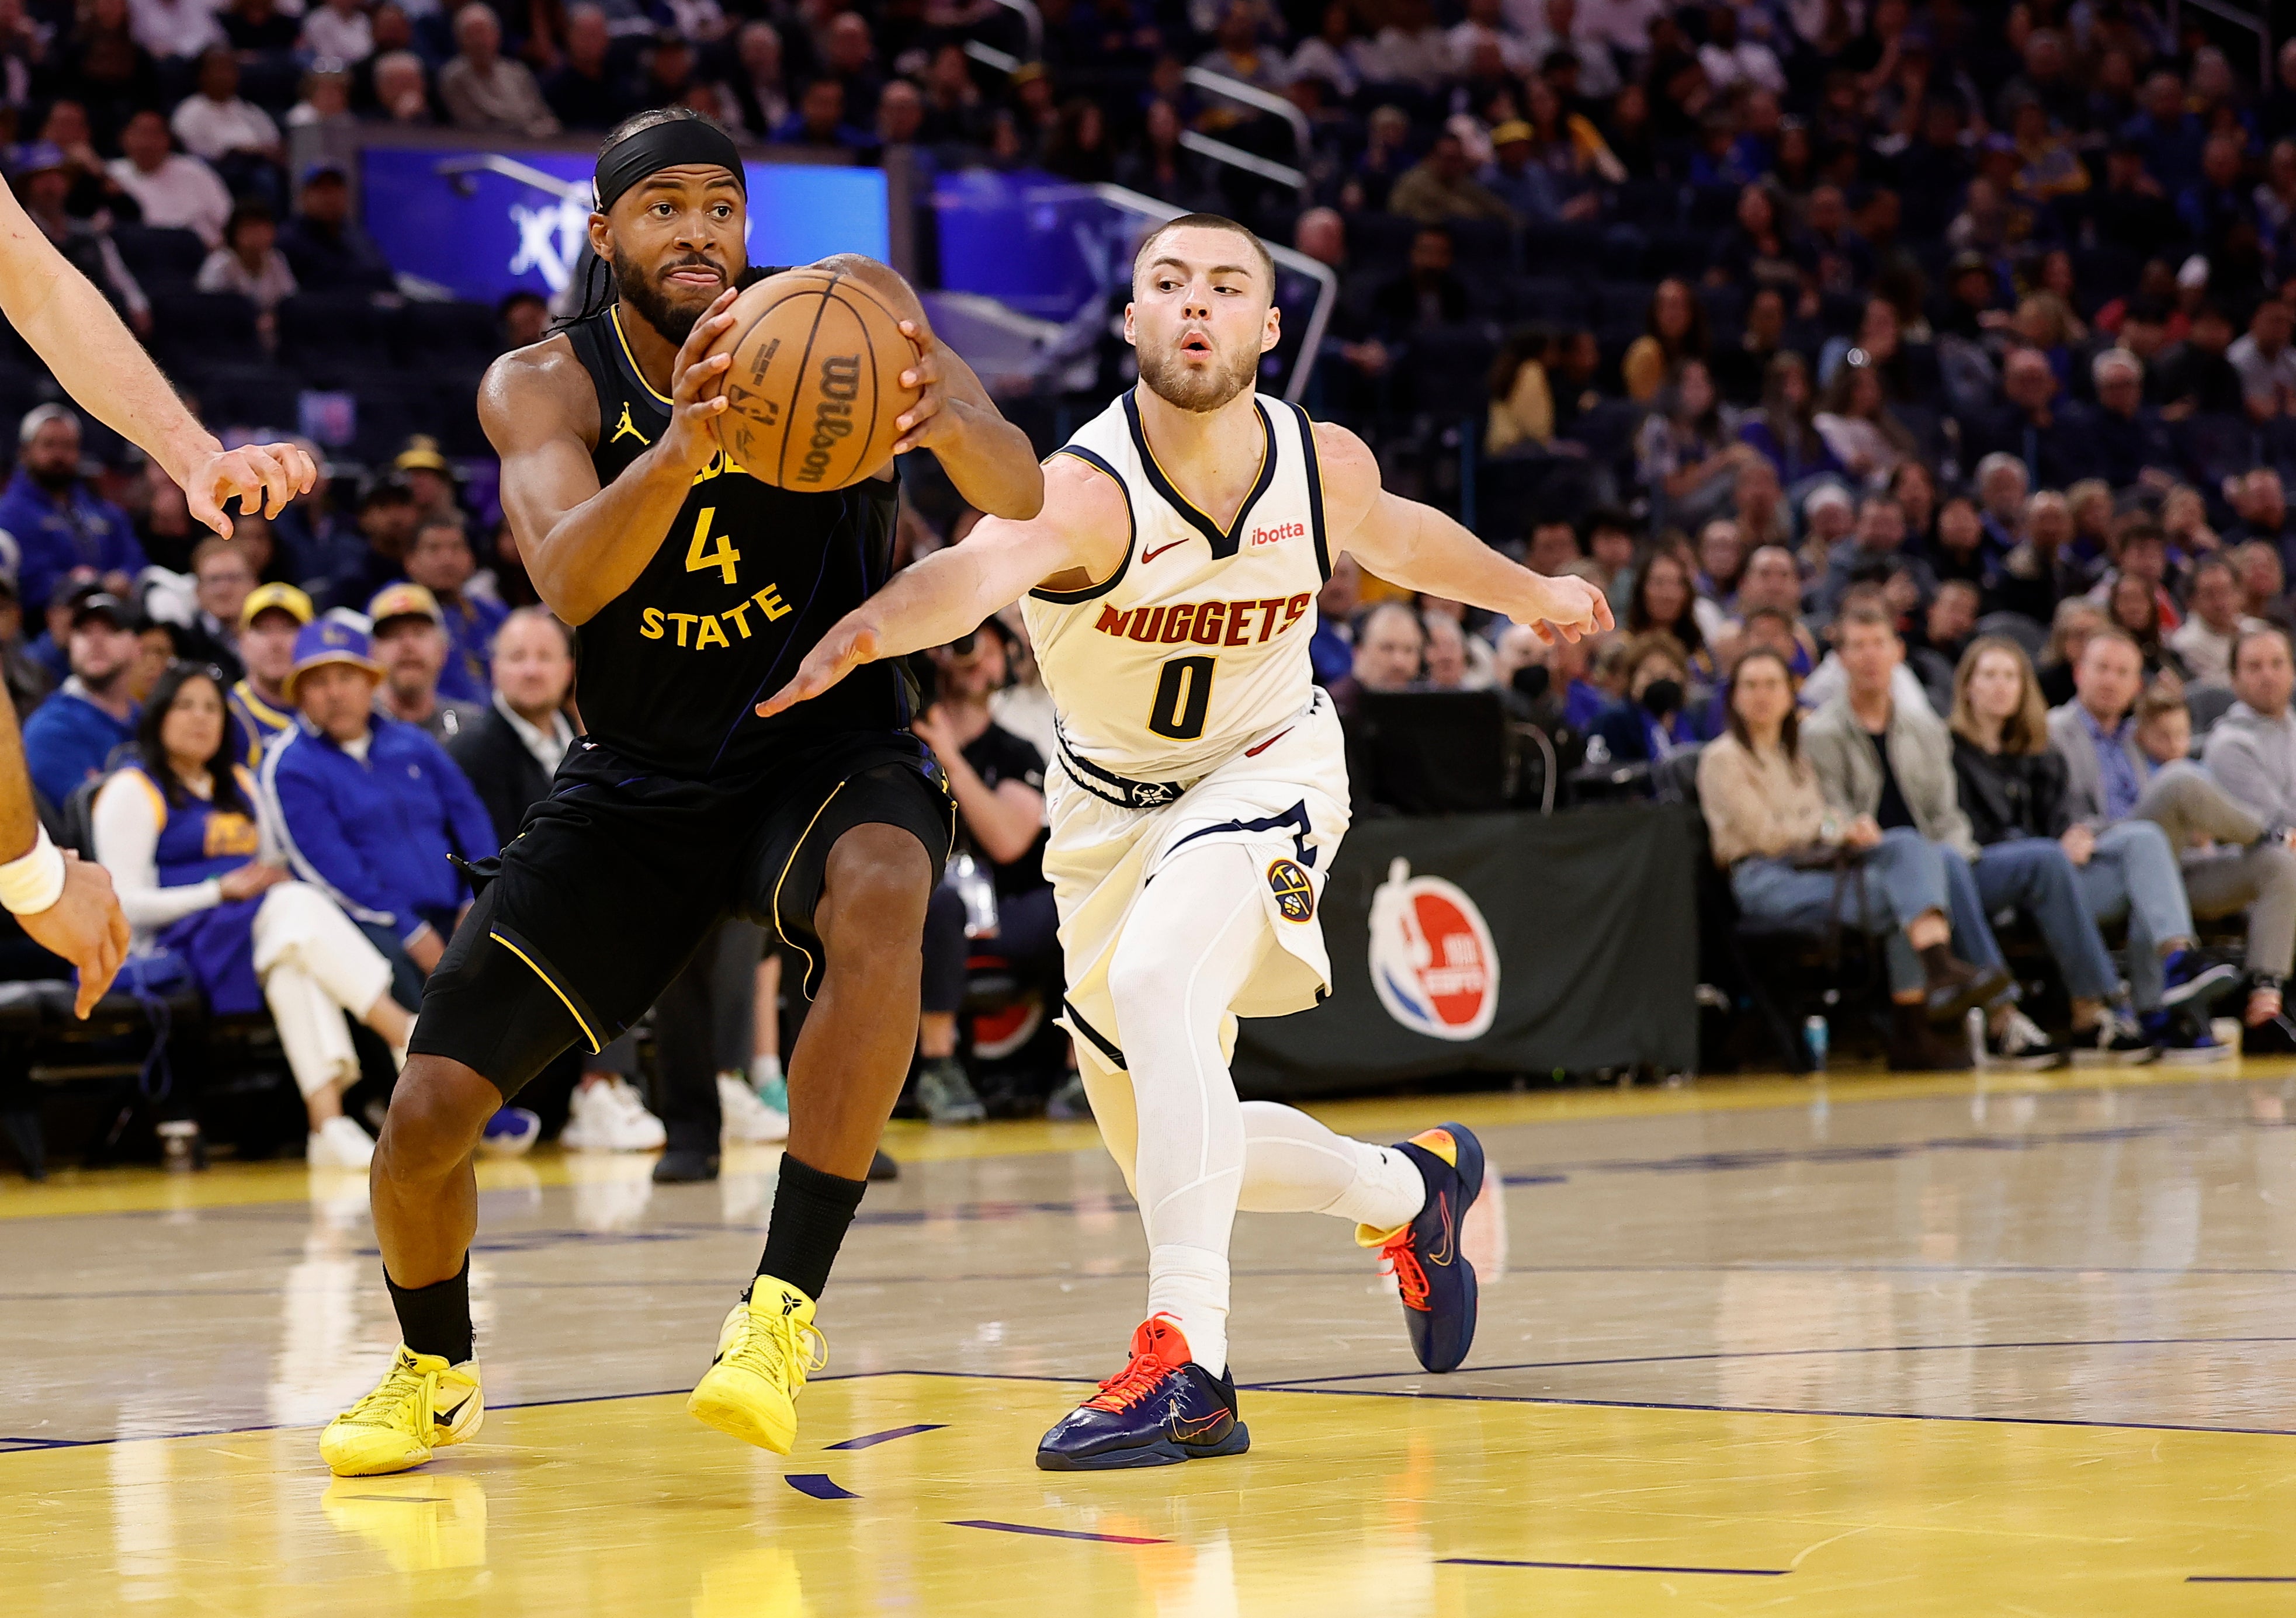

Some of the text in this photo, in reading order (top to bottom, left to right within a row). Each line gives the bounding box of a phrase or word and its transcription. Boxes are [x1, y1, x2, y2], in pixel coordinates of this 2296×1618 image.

[797, 354, 861, 483] Wilson
[685, 506, 740, 584] 4
[1252, 523, 1304, 546] ibotta
[640, 583, 793, 650] STATE
[1092, 591, 1312, 648] NUGGETS
[1145, 654, 1220, 742] 0
